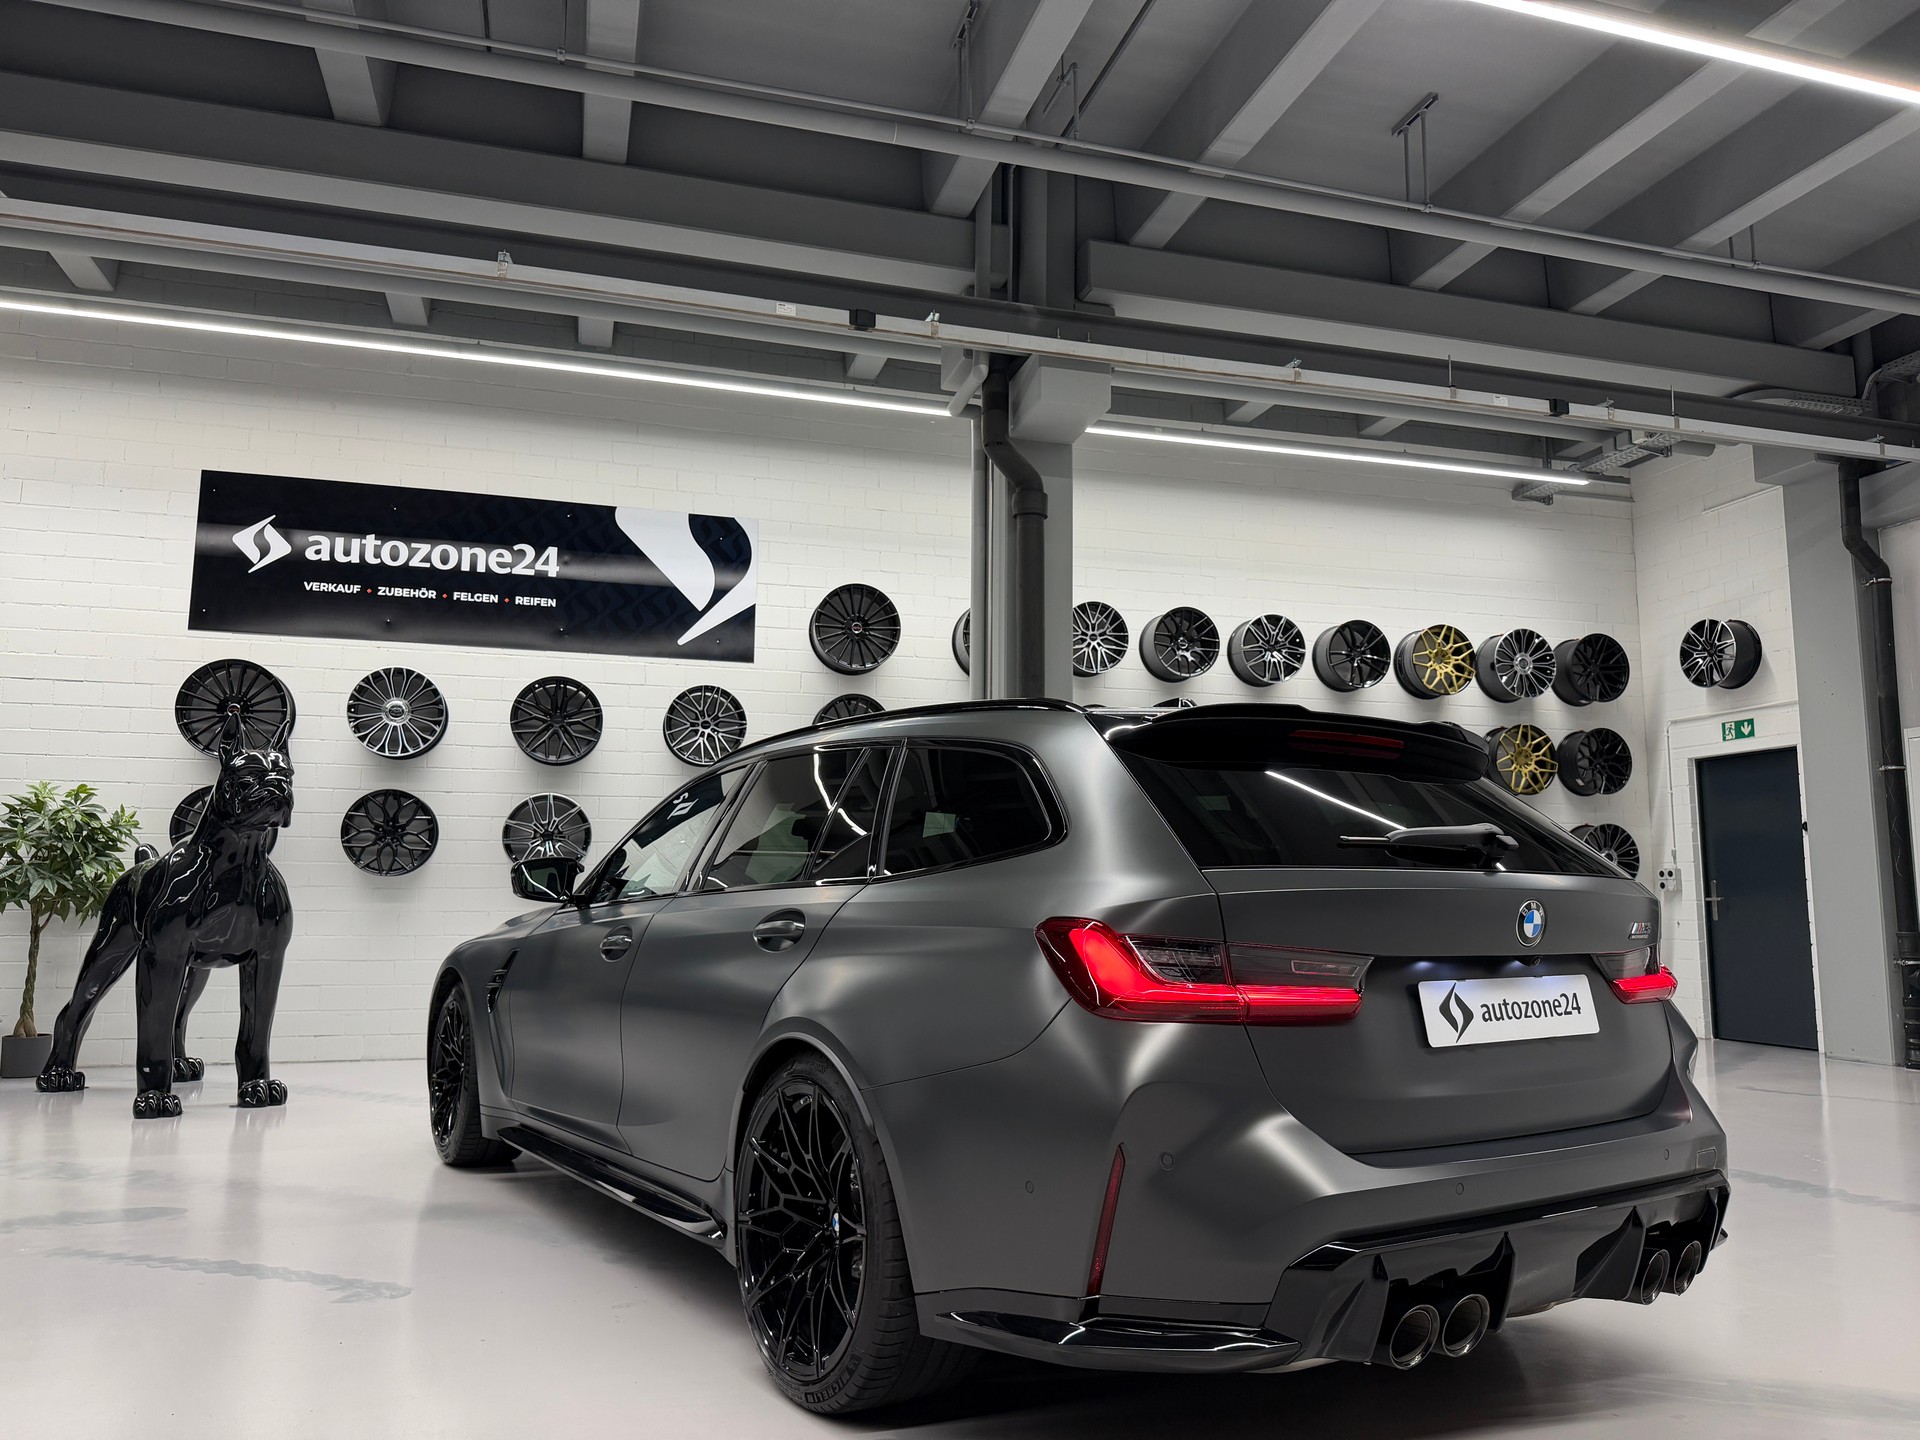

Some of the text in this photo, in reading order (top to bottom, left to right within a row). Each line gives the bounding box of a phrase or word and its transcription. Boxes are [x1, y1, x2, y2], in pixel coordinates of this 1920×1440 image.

[304, 533, 560, 578] autozone24
[303, 581, 557, 607] VERKAUF ZUBEHÖR FELGEN REIFEN
[1480, 992, 1582, 1023] autozone24
[806, 1370, 850, 1402] MICHELIN
